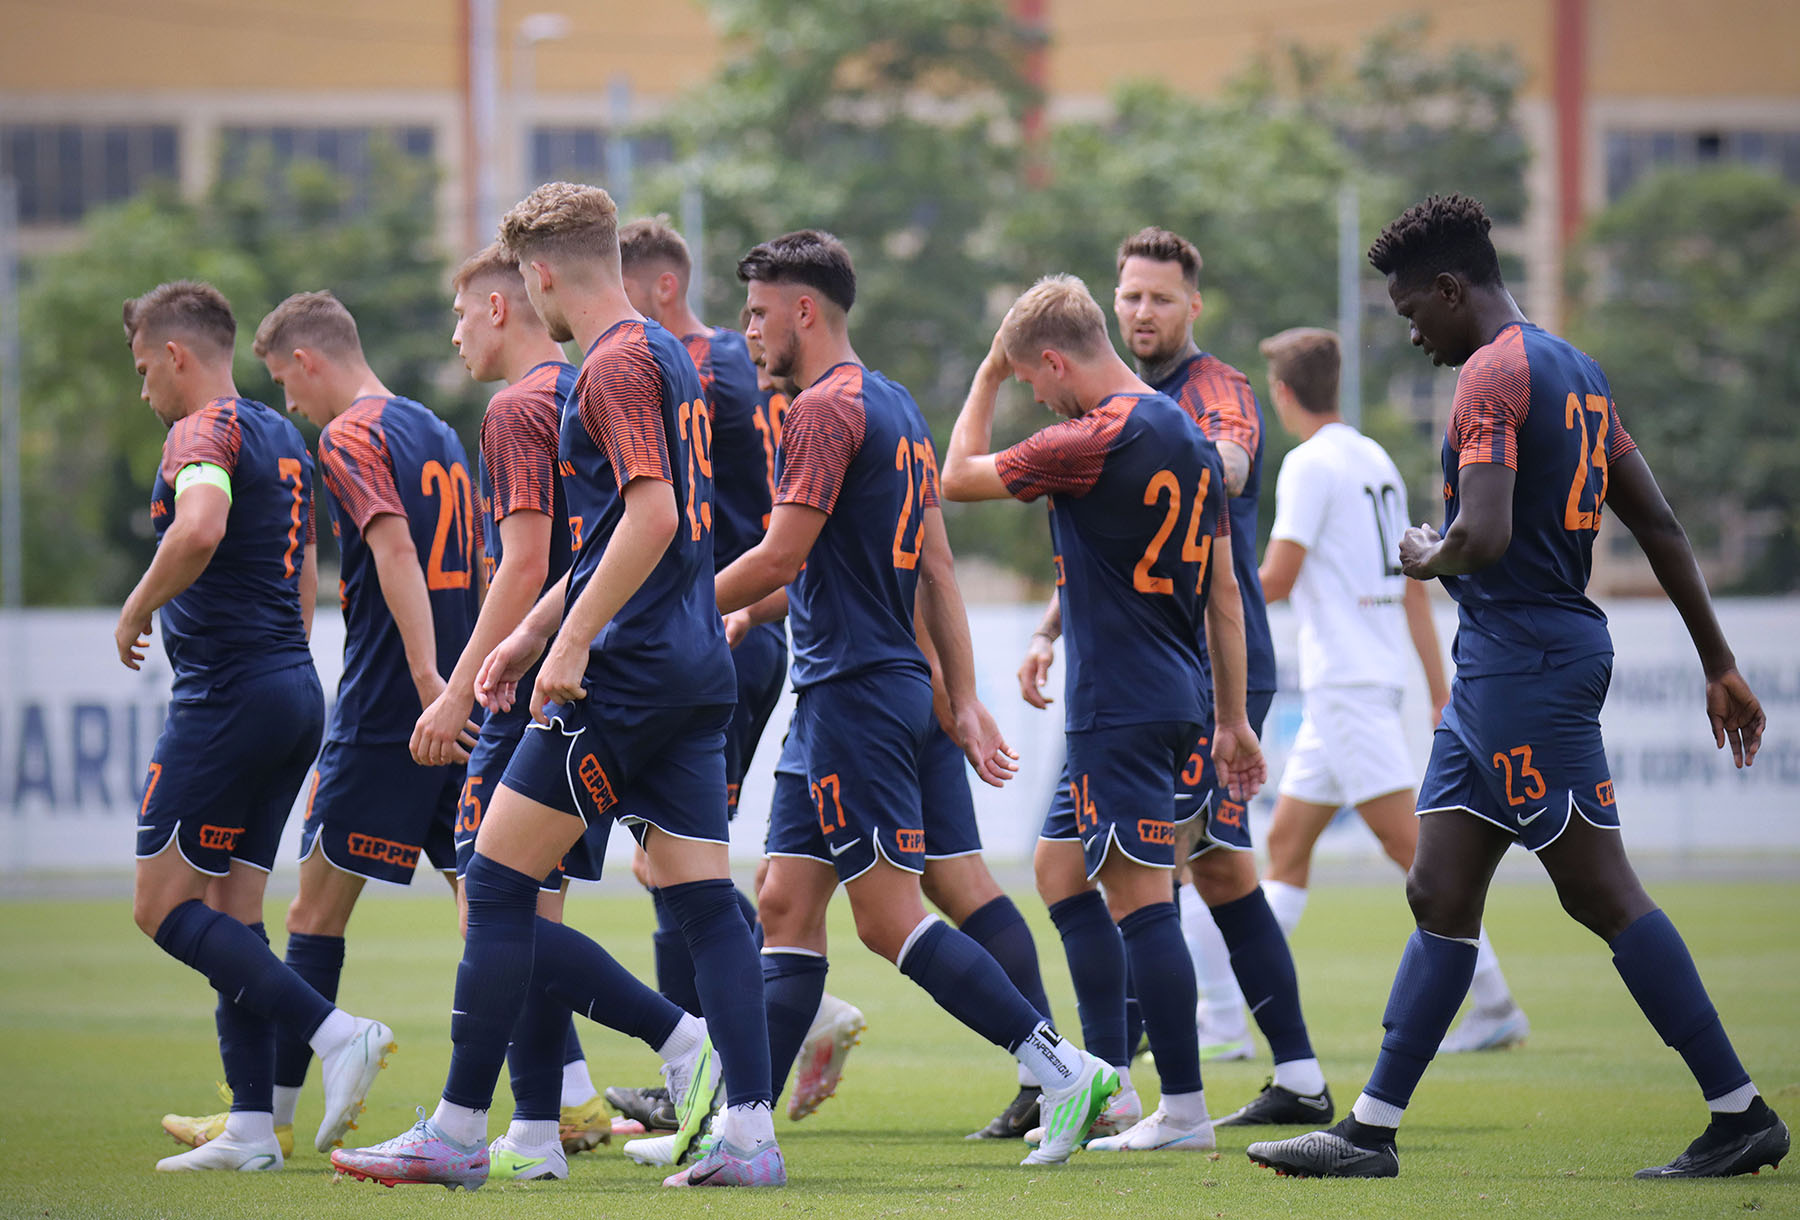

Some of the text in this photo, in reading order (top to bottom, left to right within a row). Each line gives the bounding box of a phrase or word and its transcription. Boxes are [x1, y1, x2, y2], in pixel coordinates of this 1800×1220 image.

[1564, 391, 1609, 531] 23
[278, 457, 303, 579] 7
[421, 460, 474, 591] 20
[1133, 468, 1212, 595] 24
[141, 762, 162, 816] 7
[811, 773, 846, 835] 27
[1070, 774, 1098, 834] 24
[1493, 744, 1546, 806] 23
